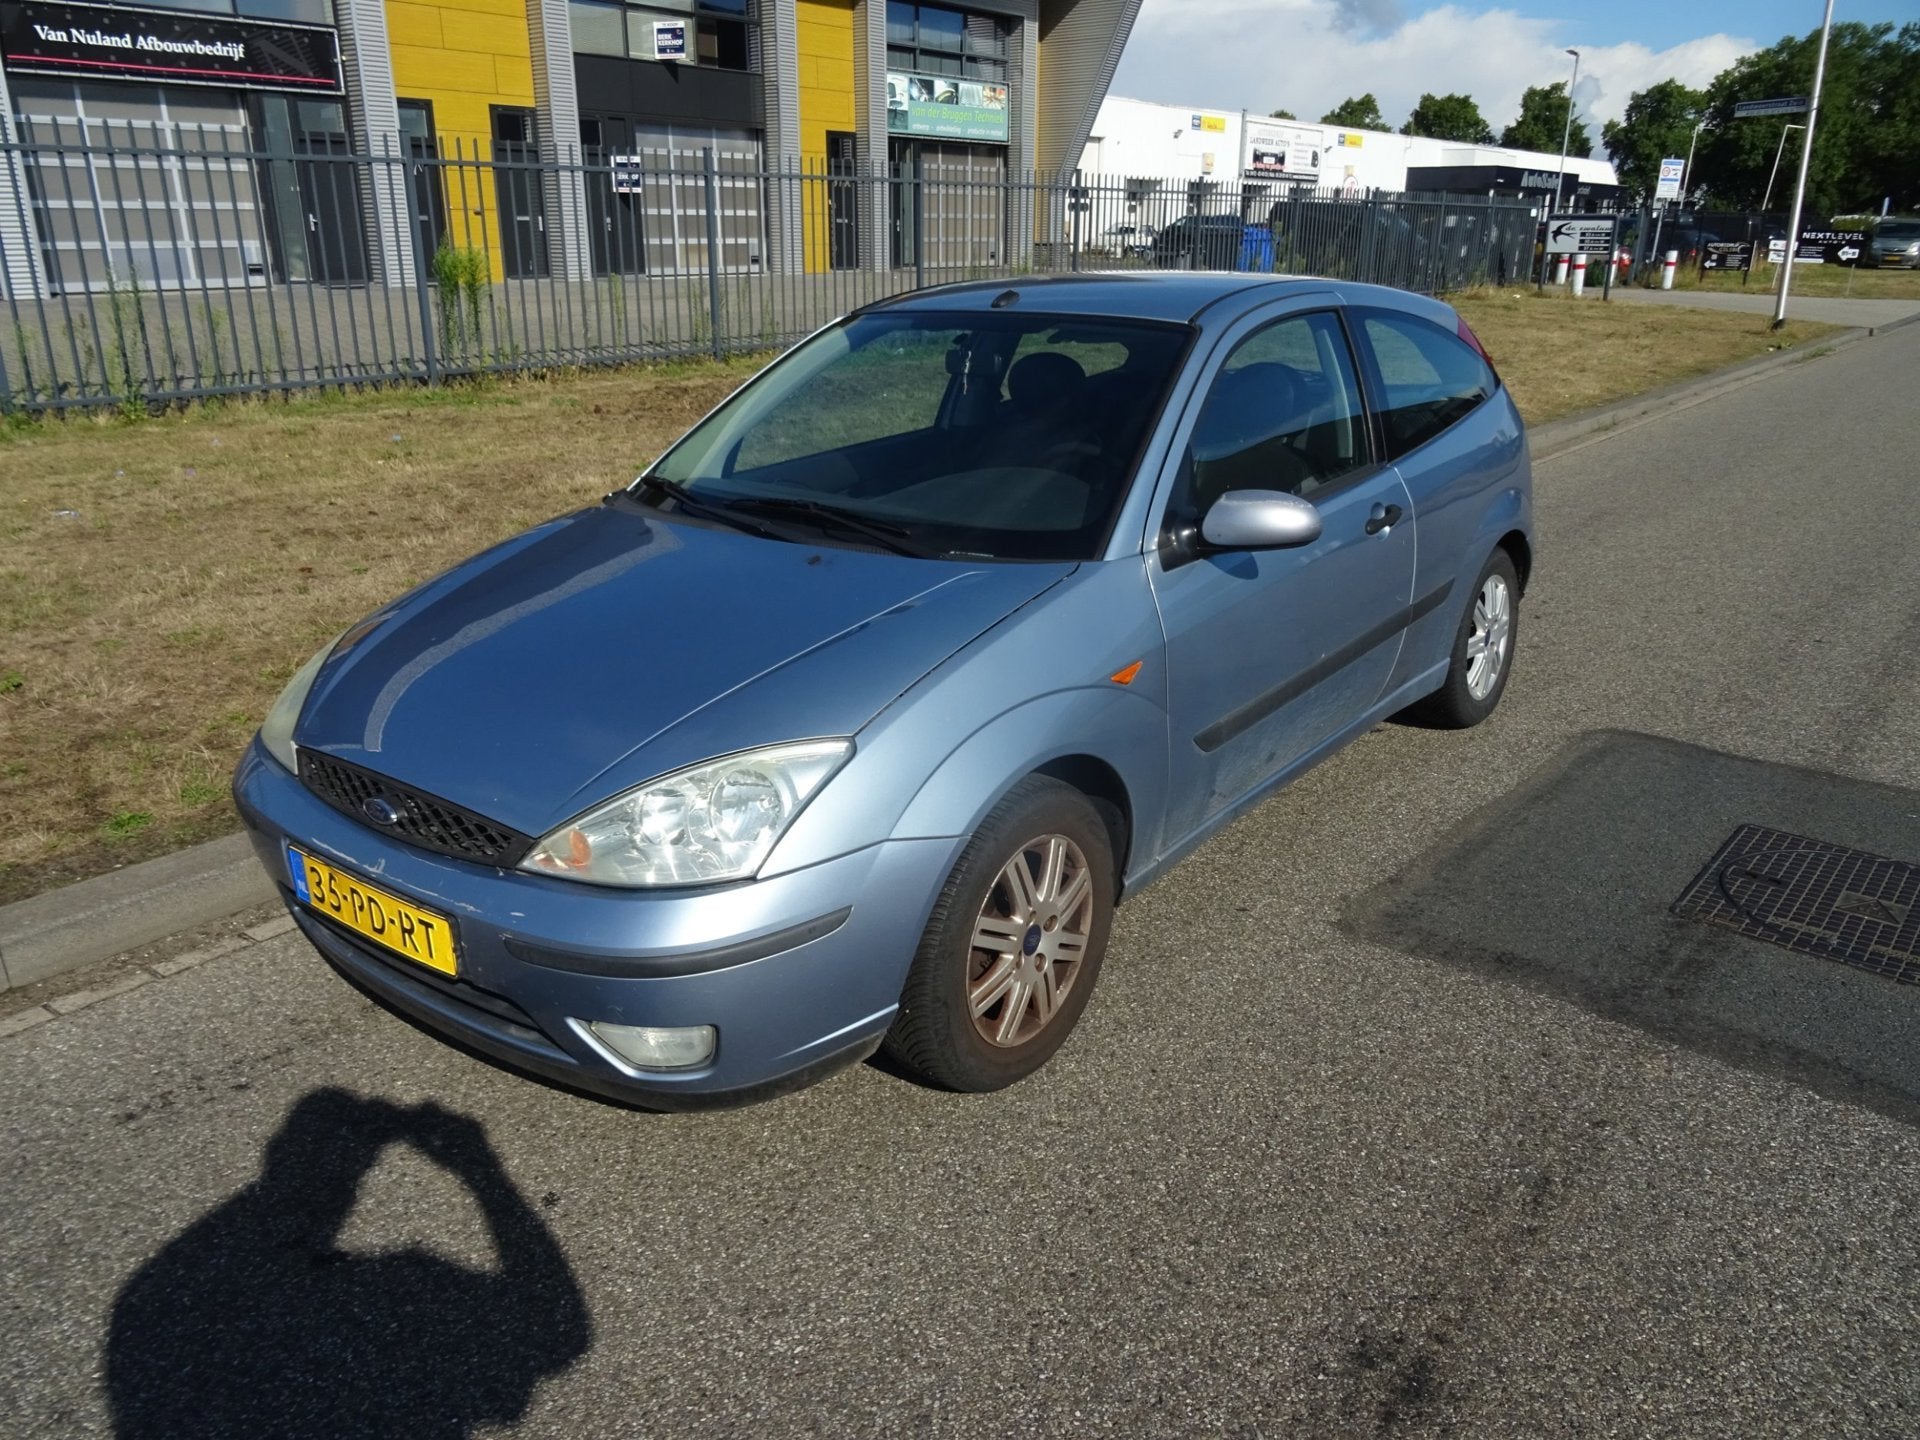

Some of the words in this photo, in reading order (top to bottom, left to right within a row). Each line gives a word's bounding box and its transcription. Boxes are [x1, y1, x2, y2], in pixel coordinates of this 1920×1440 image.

[33, 25, 68, 42] Van
[71, 28, 133, 49] Nuland
[135, 33, 246, 61] Afbouwbedrijf
[912, 107, 926, 117] van
[928, 104, 941, 118] der
[942, 107, 972, 123] Bruggen
[975, 110, 1005, 125] Techniek
[1520, 170, 1562, 190] AutoSale
[1802, 232, 1865, 240] NEXTLEVEL
[309, 866, 436, 960] 35-PD-RT
